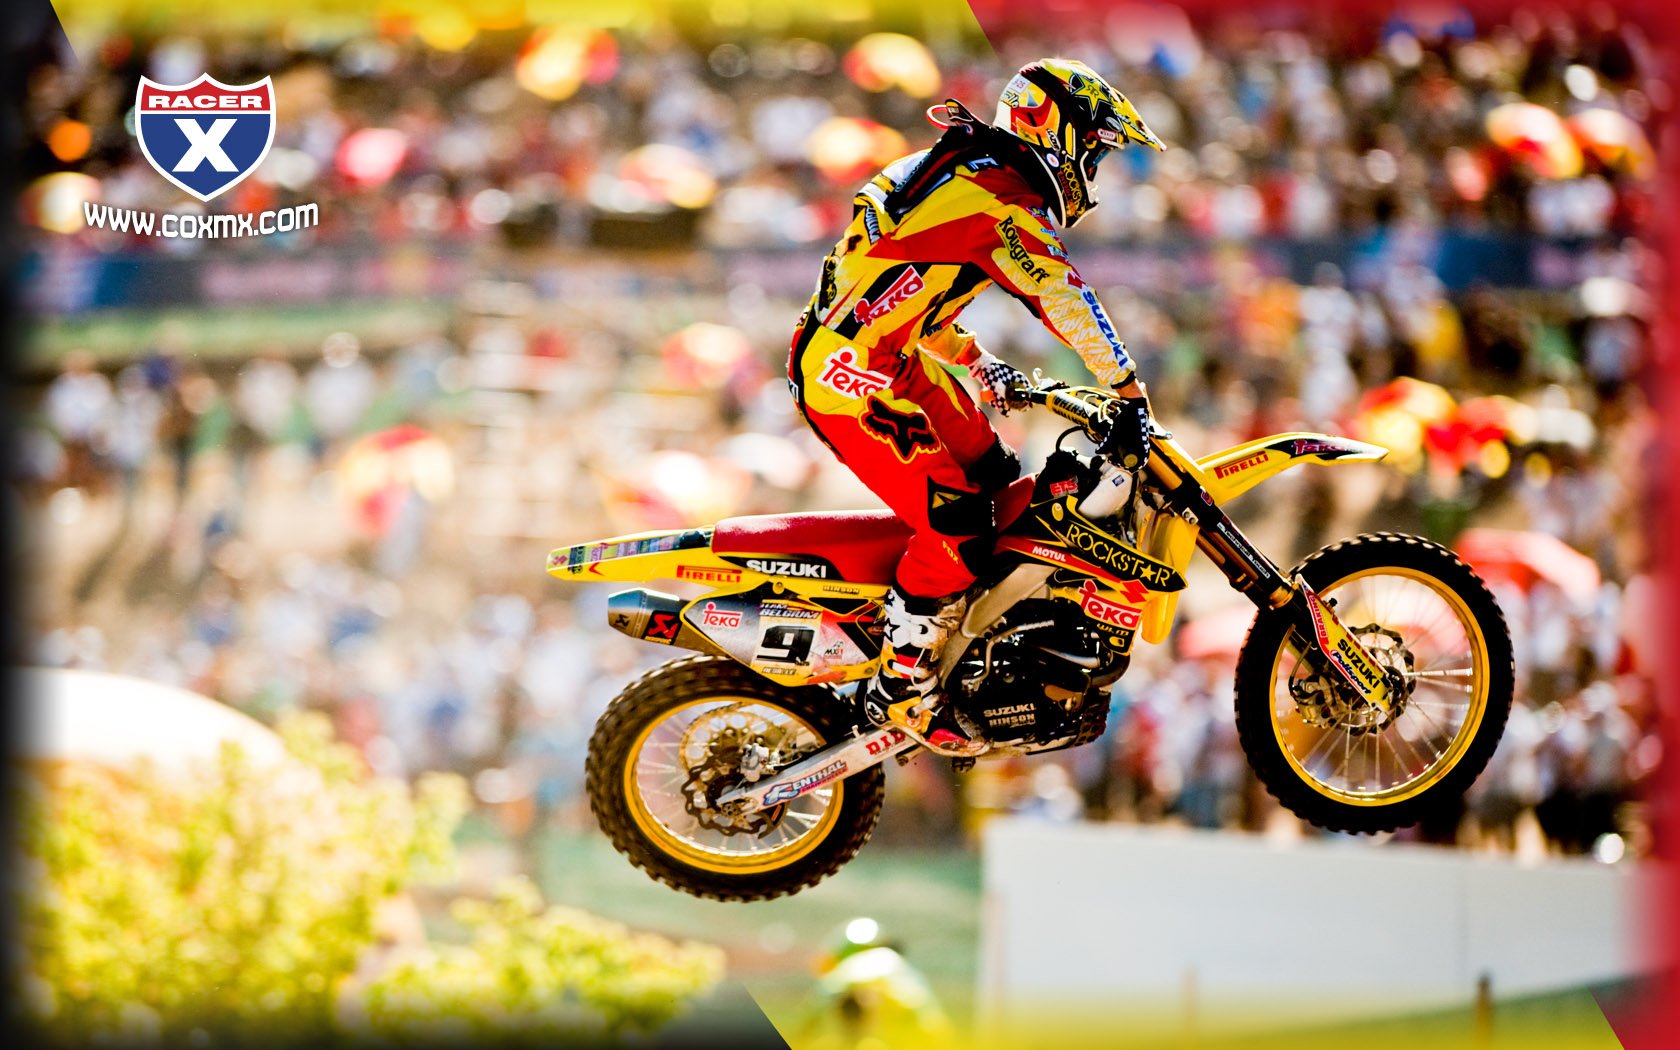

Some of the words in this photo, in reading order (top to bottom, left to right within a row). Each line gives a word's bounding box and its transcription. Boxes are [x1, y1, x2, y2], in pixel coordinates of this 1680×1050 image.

[998, 215, 1050, 284] Rougraff
[1082, 290, 1129, 369] SUZUKI
[1213, 451, 1269, 479] PIRELLI
[1032, 546, 1067, 562] MOTUL
[676, 565, 742, 583] PIRELLI
[746, 559, 827, 579] SUZUKI
[759, 608, 820, 620] BELGIUM
[756, 625, 815, 663] 9
[1337, 638, 1380, 689] SUZUKI
[983, 703, 1036, 717] SUZUKI
[988, 713, 1035, 728] HINSON
